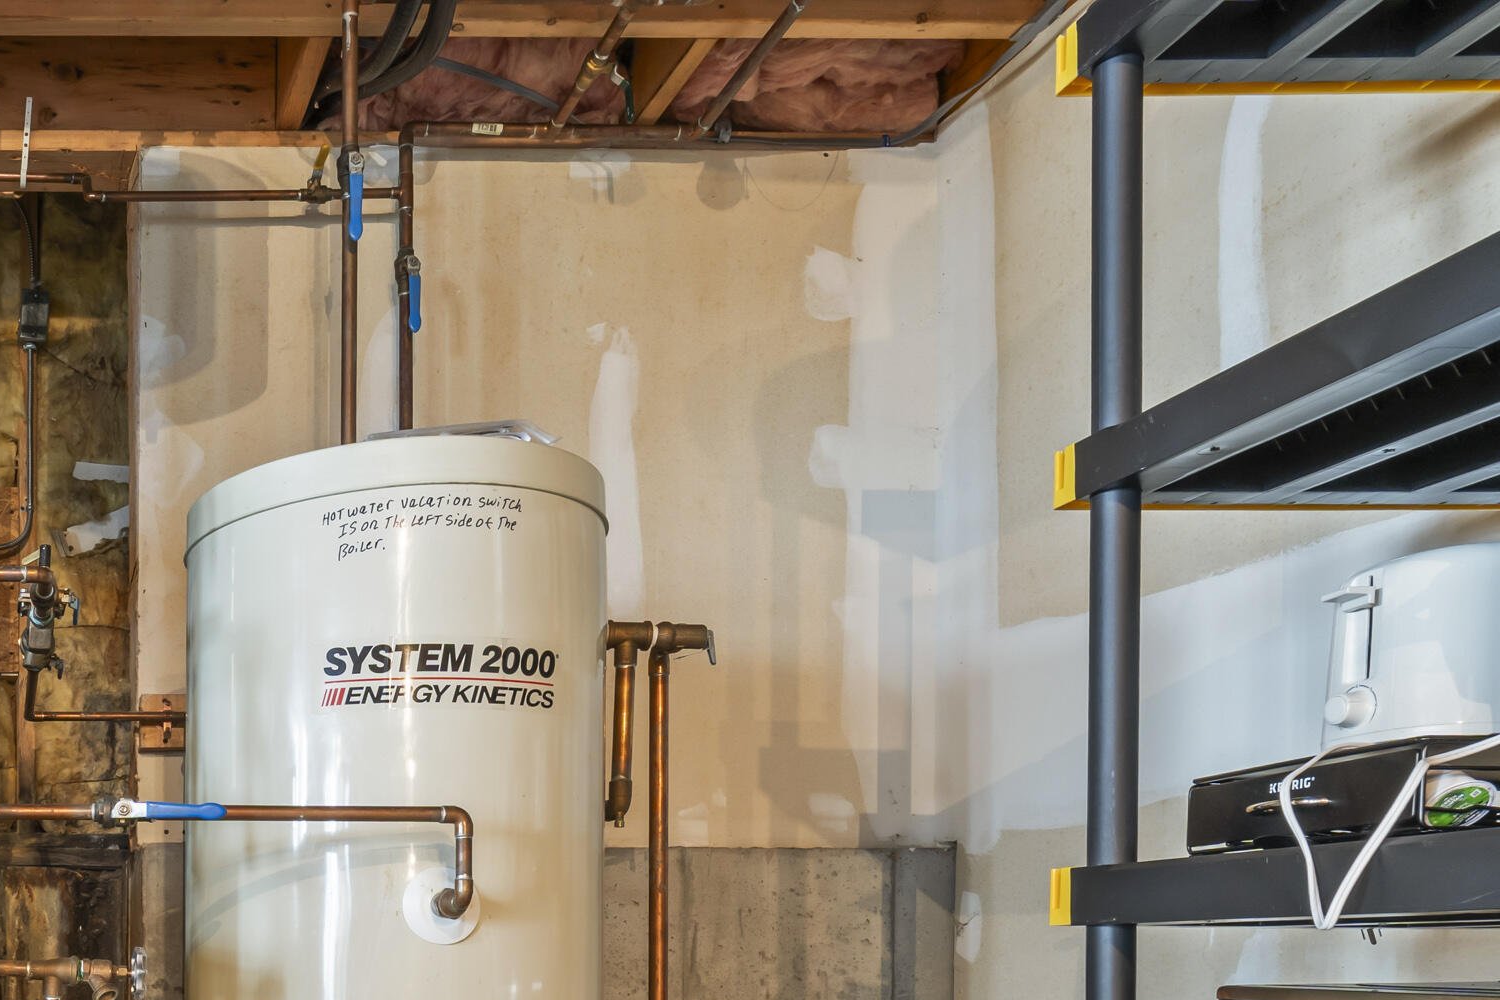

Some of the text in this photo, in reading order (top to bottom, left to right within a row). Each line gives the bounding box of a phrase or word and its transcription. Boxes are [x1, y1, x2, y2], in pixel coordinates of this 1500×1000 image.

[323, 643, 556, 679] SYSTEM 2000
[344, 684, 555, 709] ENERGY KINETICS
[1269, 777, 1311, 793] KERIG
